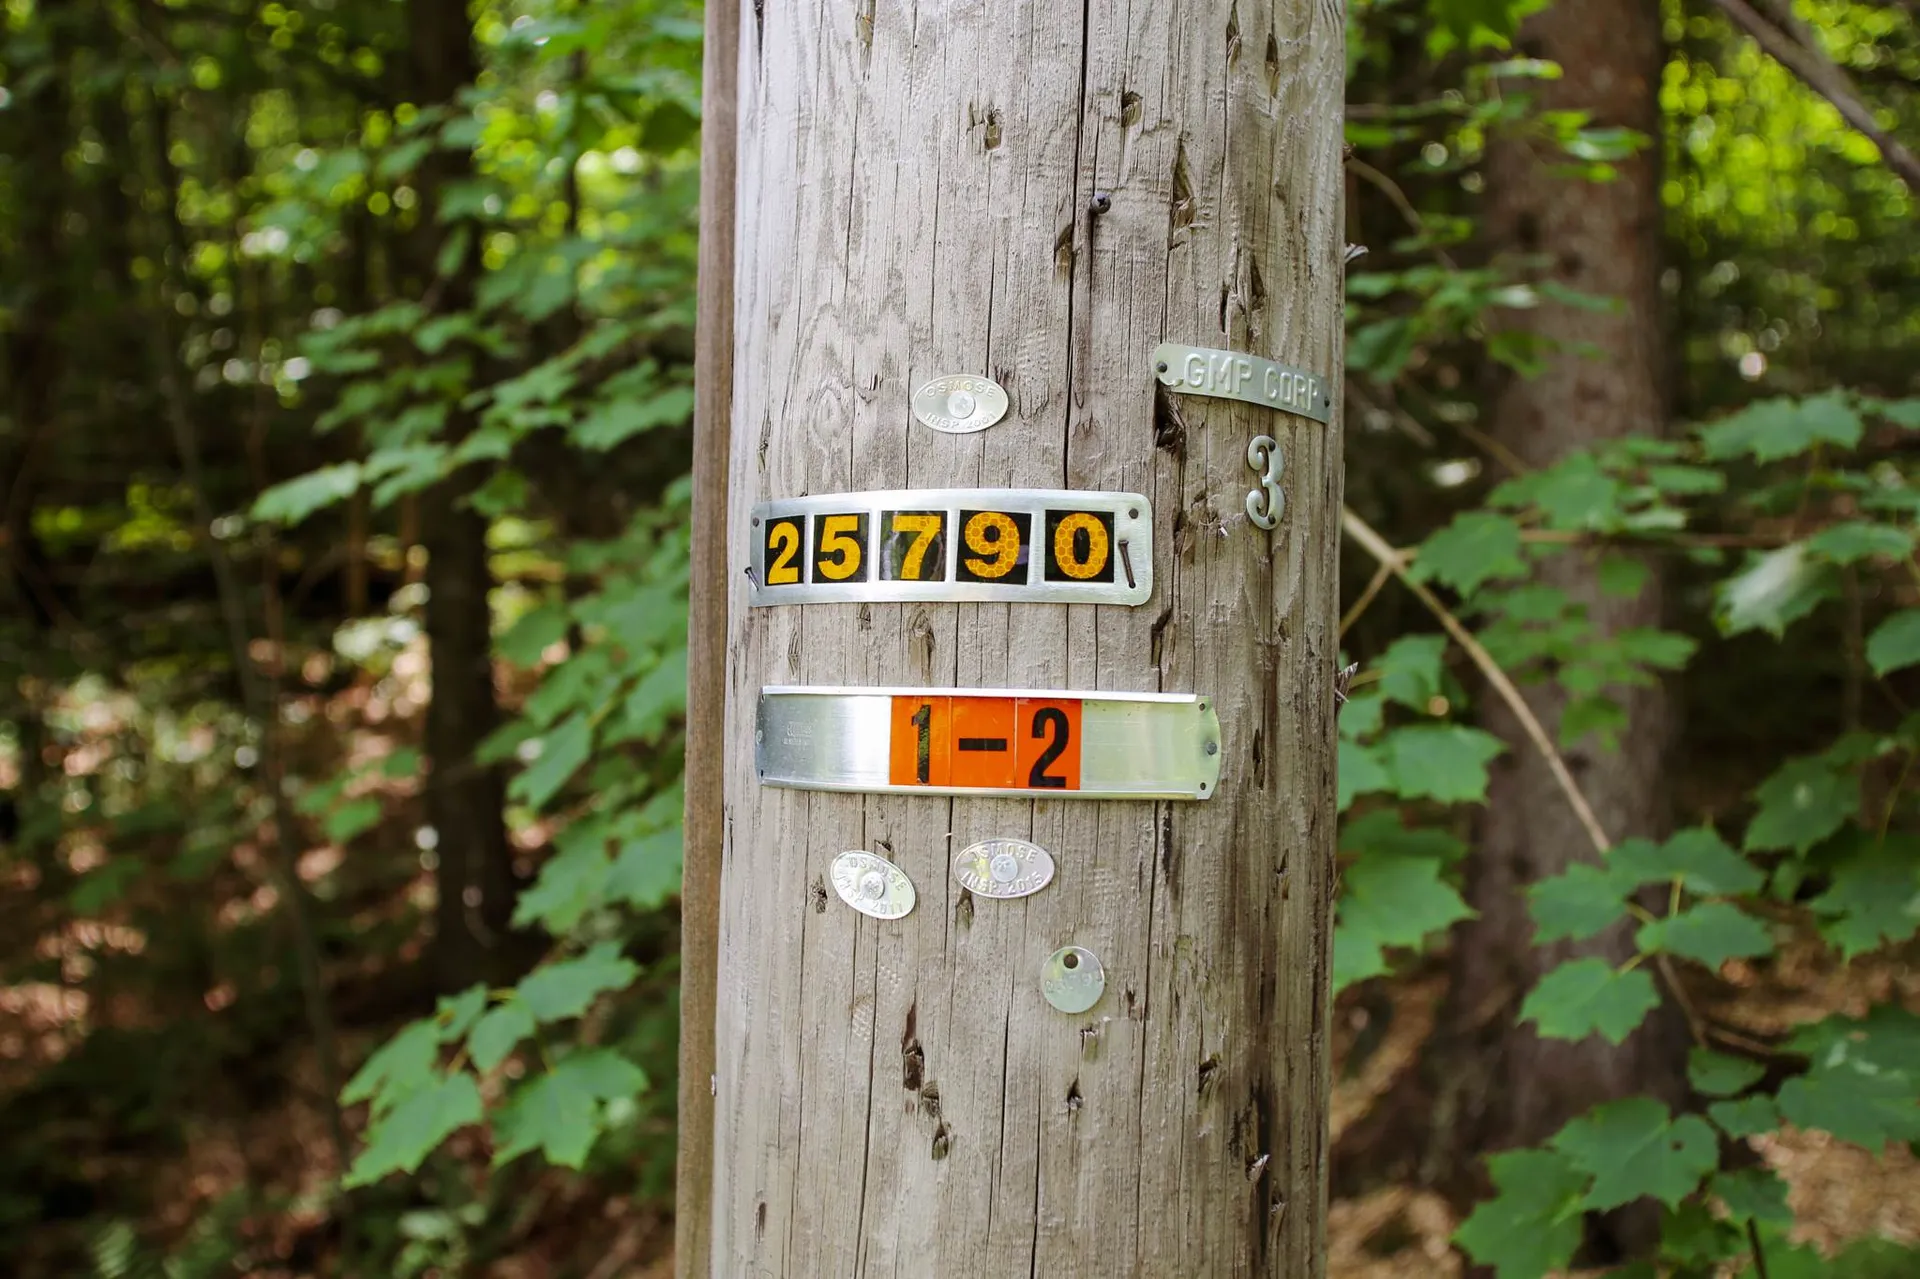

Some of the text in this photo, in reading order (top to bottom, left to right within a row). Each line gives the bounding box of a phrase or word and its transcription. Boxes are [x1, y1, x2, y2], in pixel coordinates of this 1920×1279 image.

[926, 380, 997, 397] OSMOSE
[1184, 353, 1319, 412] GMP CORP
[1246, 435, 1286, 530] 3
[768, 511, 1110, 585] 25790
[911, 704, 1070, 788] 1-2
[1006, 870, 1044, 895] 2015
